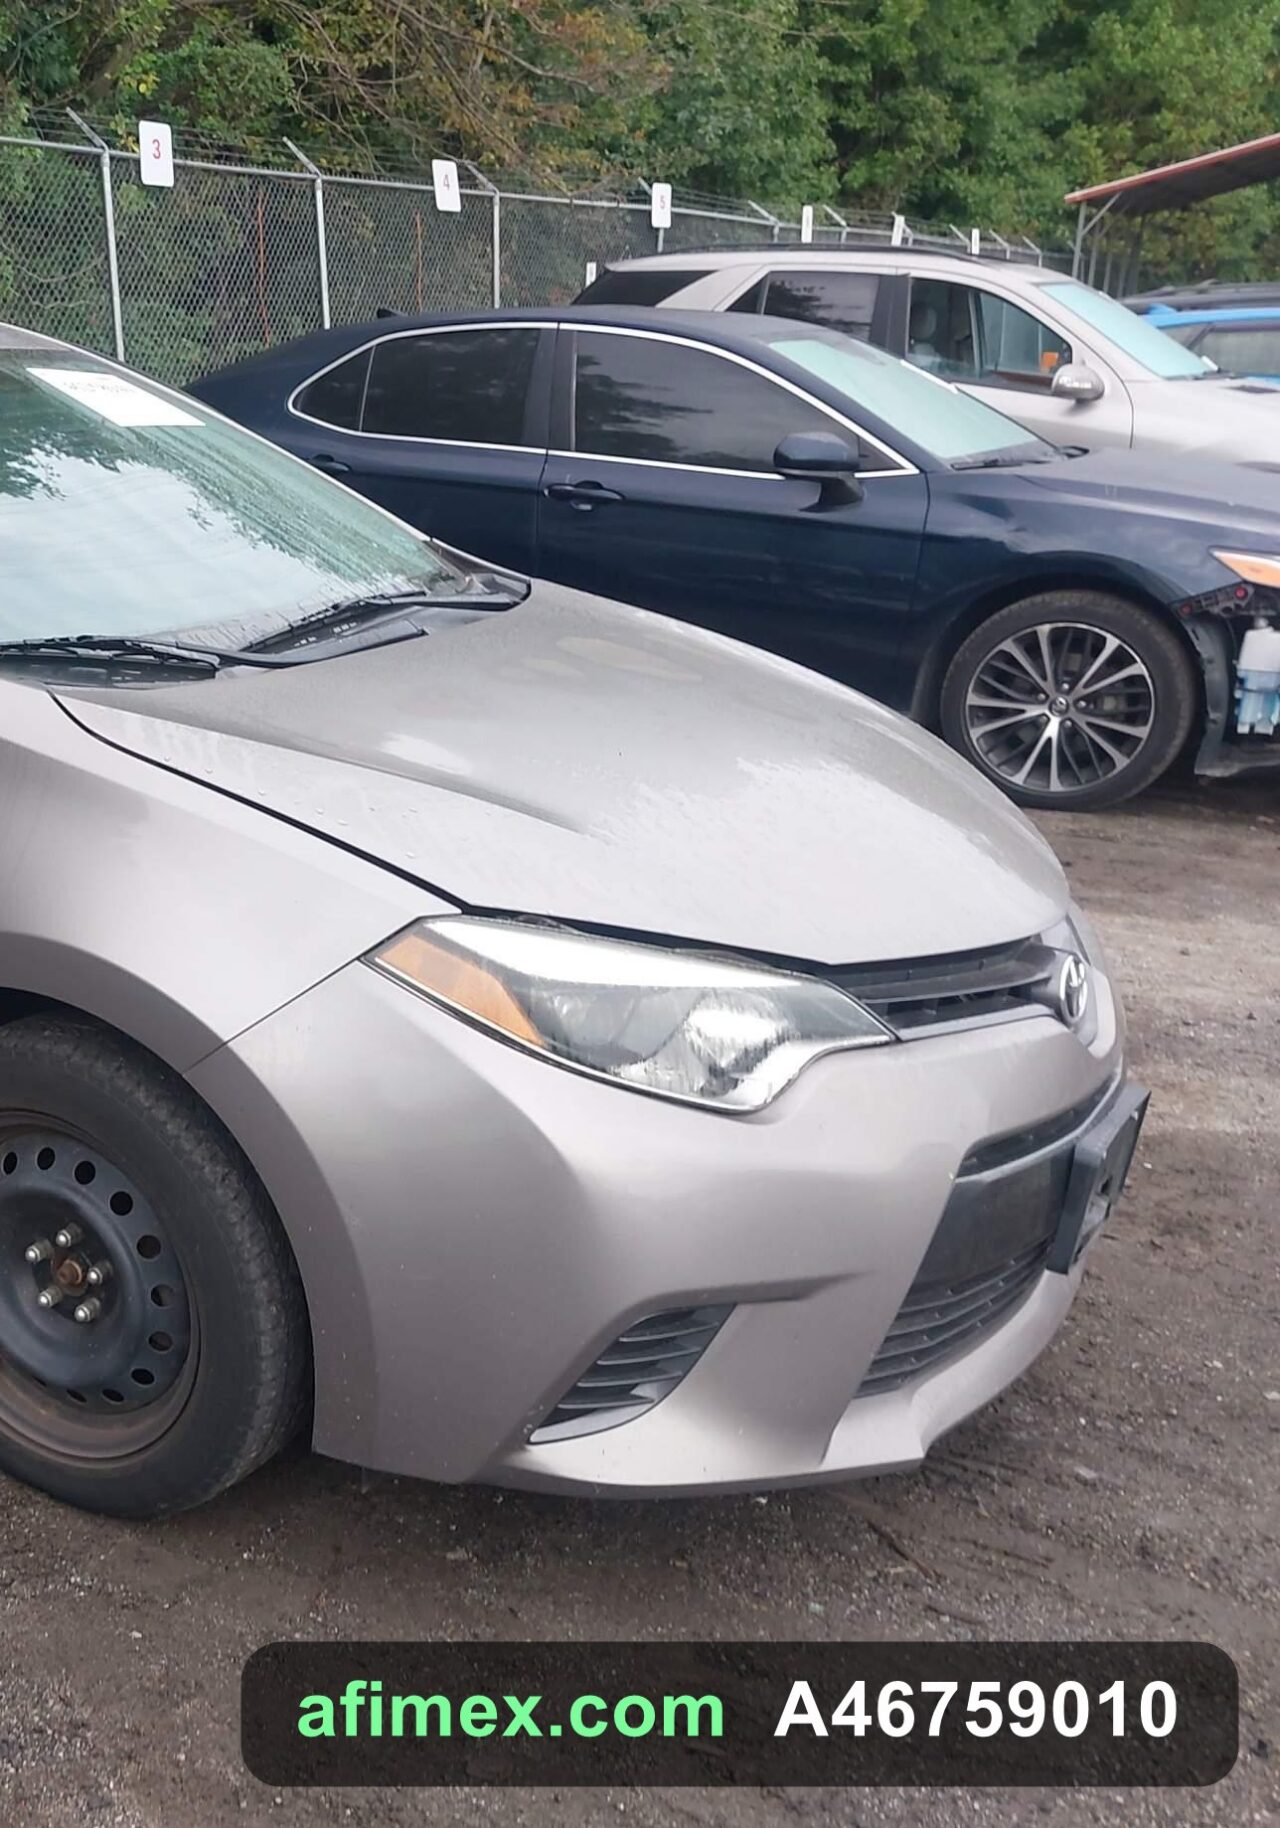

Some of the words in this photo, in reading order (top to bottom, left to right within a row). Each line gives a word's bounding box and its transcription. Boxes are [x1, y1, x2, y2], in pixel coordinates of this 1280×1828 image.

[152, 138, 161, 160] 3
[443, 173, 450, 191] 4
[660, 194, 666, 210] 5
